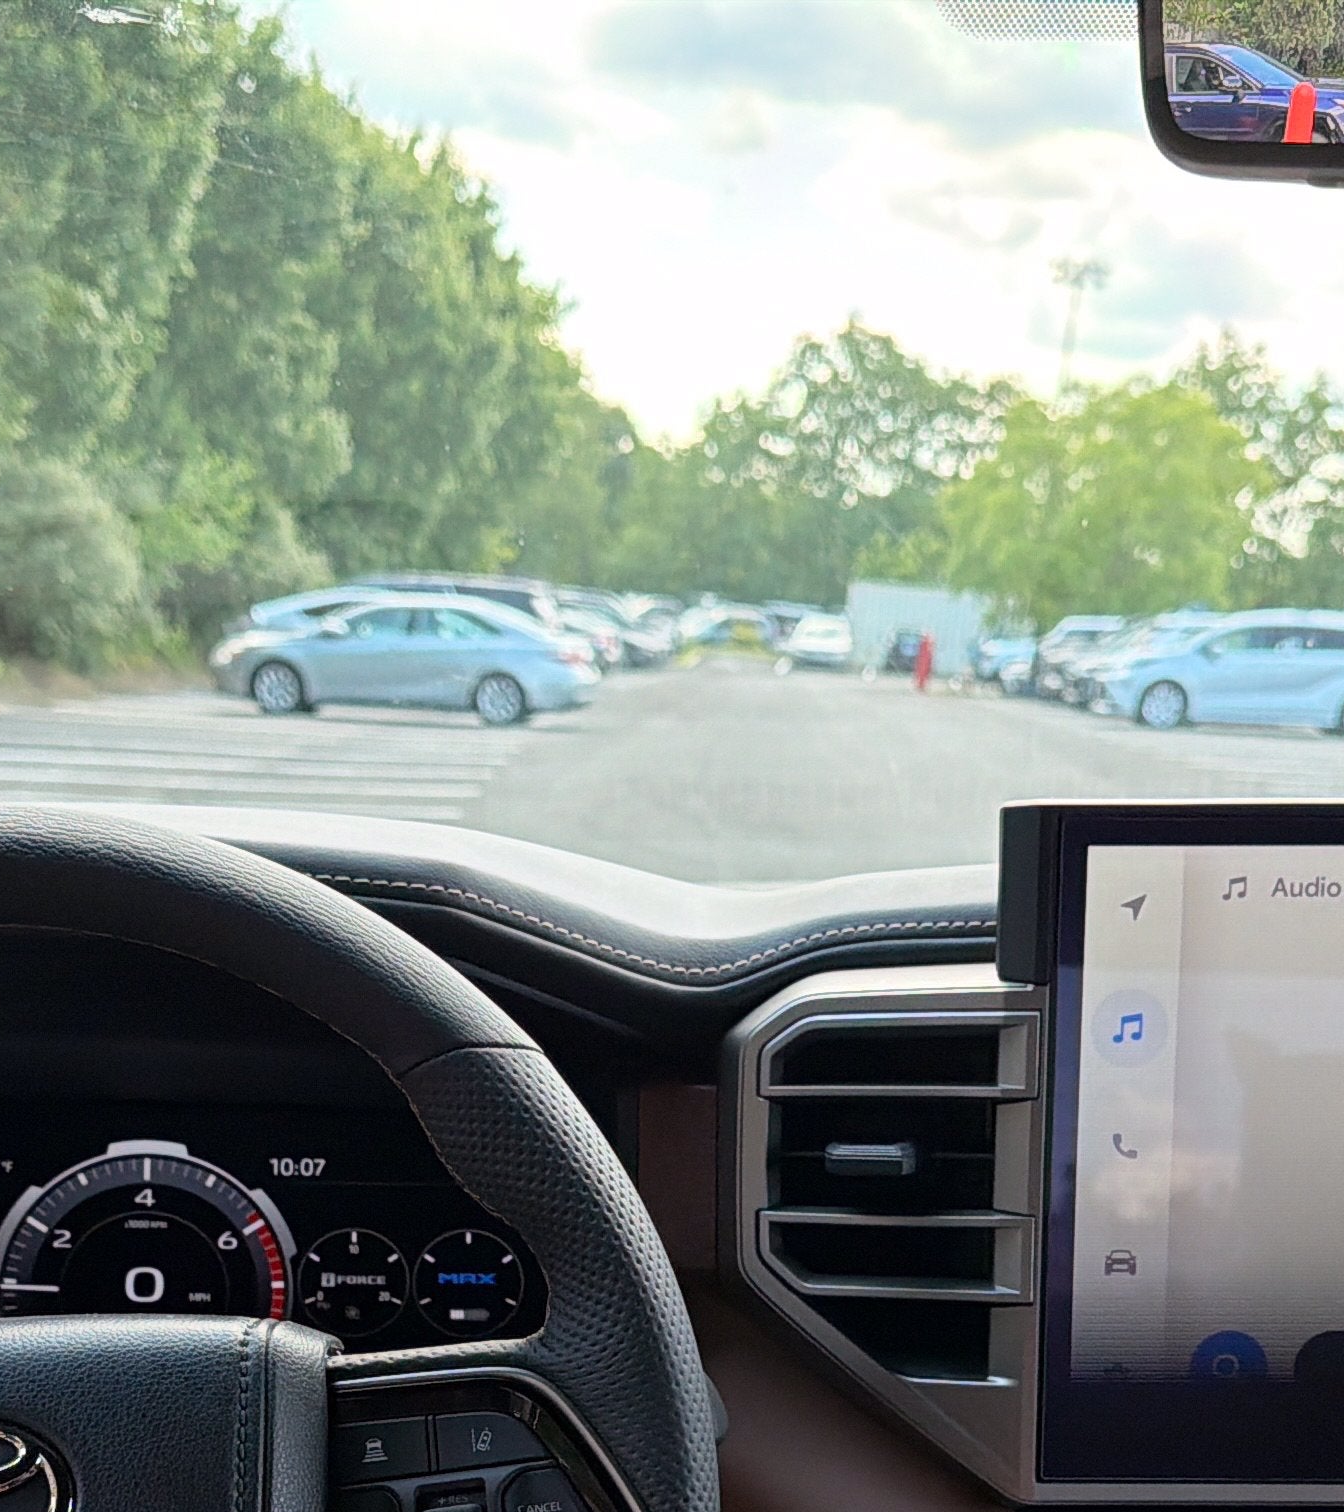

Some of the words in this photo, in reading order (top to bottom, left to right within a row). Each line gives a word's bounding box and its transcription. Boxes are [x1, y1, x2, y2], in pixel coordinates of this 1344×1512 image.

[1271, 876, 1342, 898] Audio
[269, 1158, 327, 1177] 10:07
[133, 1188, 156, 1207] 4
[52, 1229, 72, 1249] 2
[217, 1231, 238, 1250] 6
[349, 1244, 360, 1254] 10
[124, 1266, 165, 1303] 0
[337, 1274, 387, 1285] FORCE
[437, 1272, 497, 1285] MAX
[188, 1292, 211, 1303] MPH
[378, 1291, 391, 1302] 20
